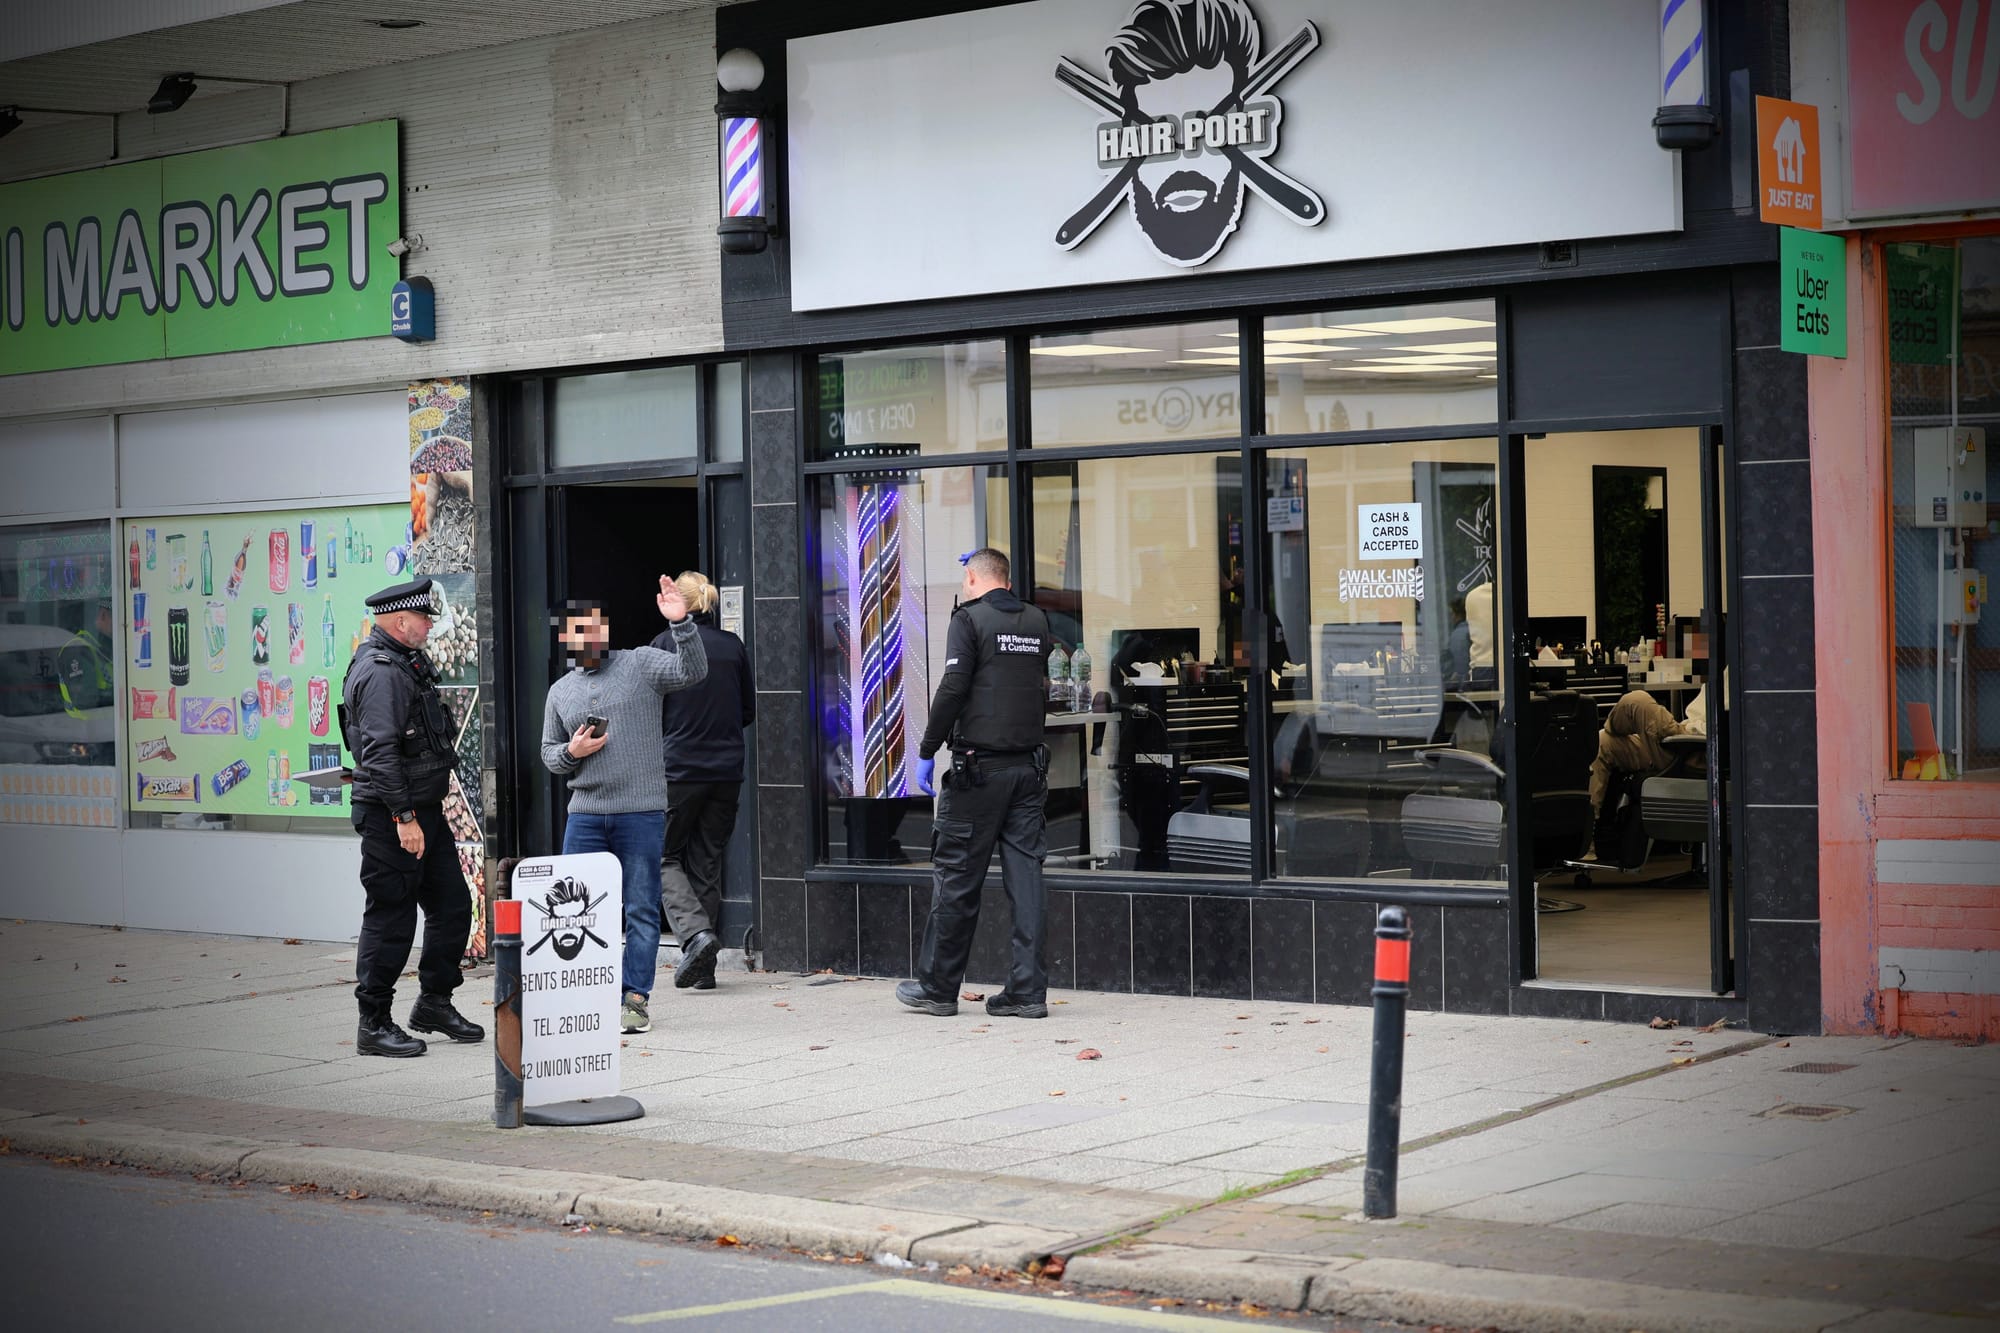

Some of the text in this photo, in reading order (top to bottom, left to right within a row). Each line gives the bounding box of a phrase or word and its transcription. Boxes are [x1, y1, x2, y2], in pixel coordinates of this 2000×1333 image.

[1099, 109, 1271, 162] HAIR PORT
[1768, 187, 1815, 211] JUST EAT
[0, 172, 388, 332] I MARKET
[1816, 253, 1824, 262] ON
[1796, 267, 1829, 301] Uber
[1796, 303, 1830, 336] Eats
[1370, 511, 1410, 523] CASH &
[1372, 526, 1409, 537] CARDS
[1363, 540, 1419, 551] ACCEPTED
[1346, 568, 1416, 583] WALK-INS
[1347, 584, 1416, 599] WELCOME
[997, 634, 1040, 645] HM Revenue
[1000, 643, 1040, 653] & Customs
[541, 912, 597, 932] HAIR PORT
[561, 966, 615, 988] BARBERS
[533, 1013, 601, 1037] TEL. 261003
[536, 1058, 571, 1079] UNION
[575, 1053, 613, 1074] STREET
